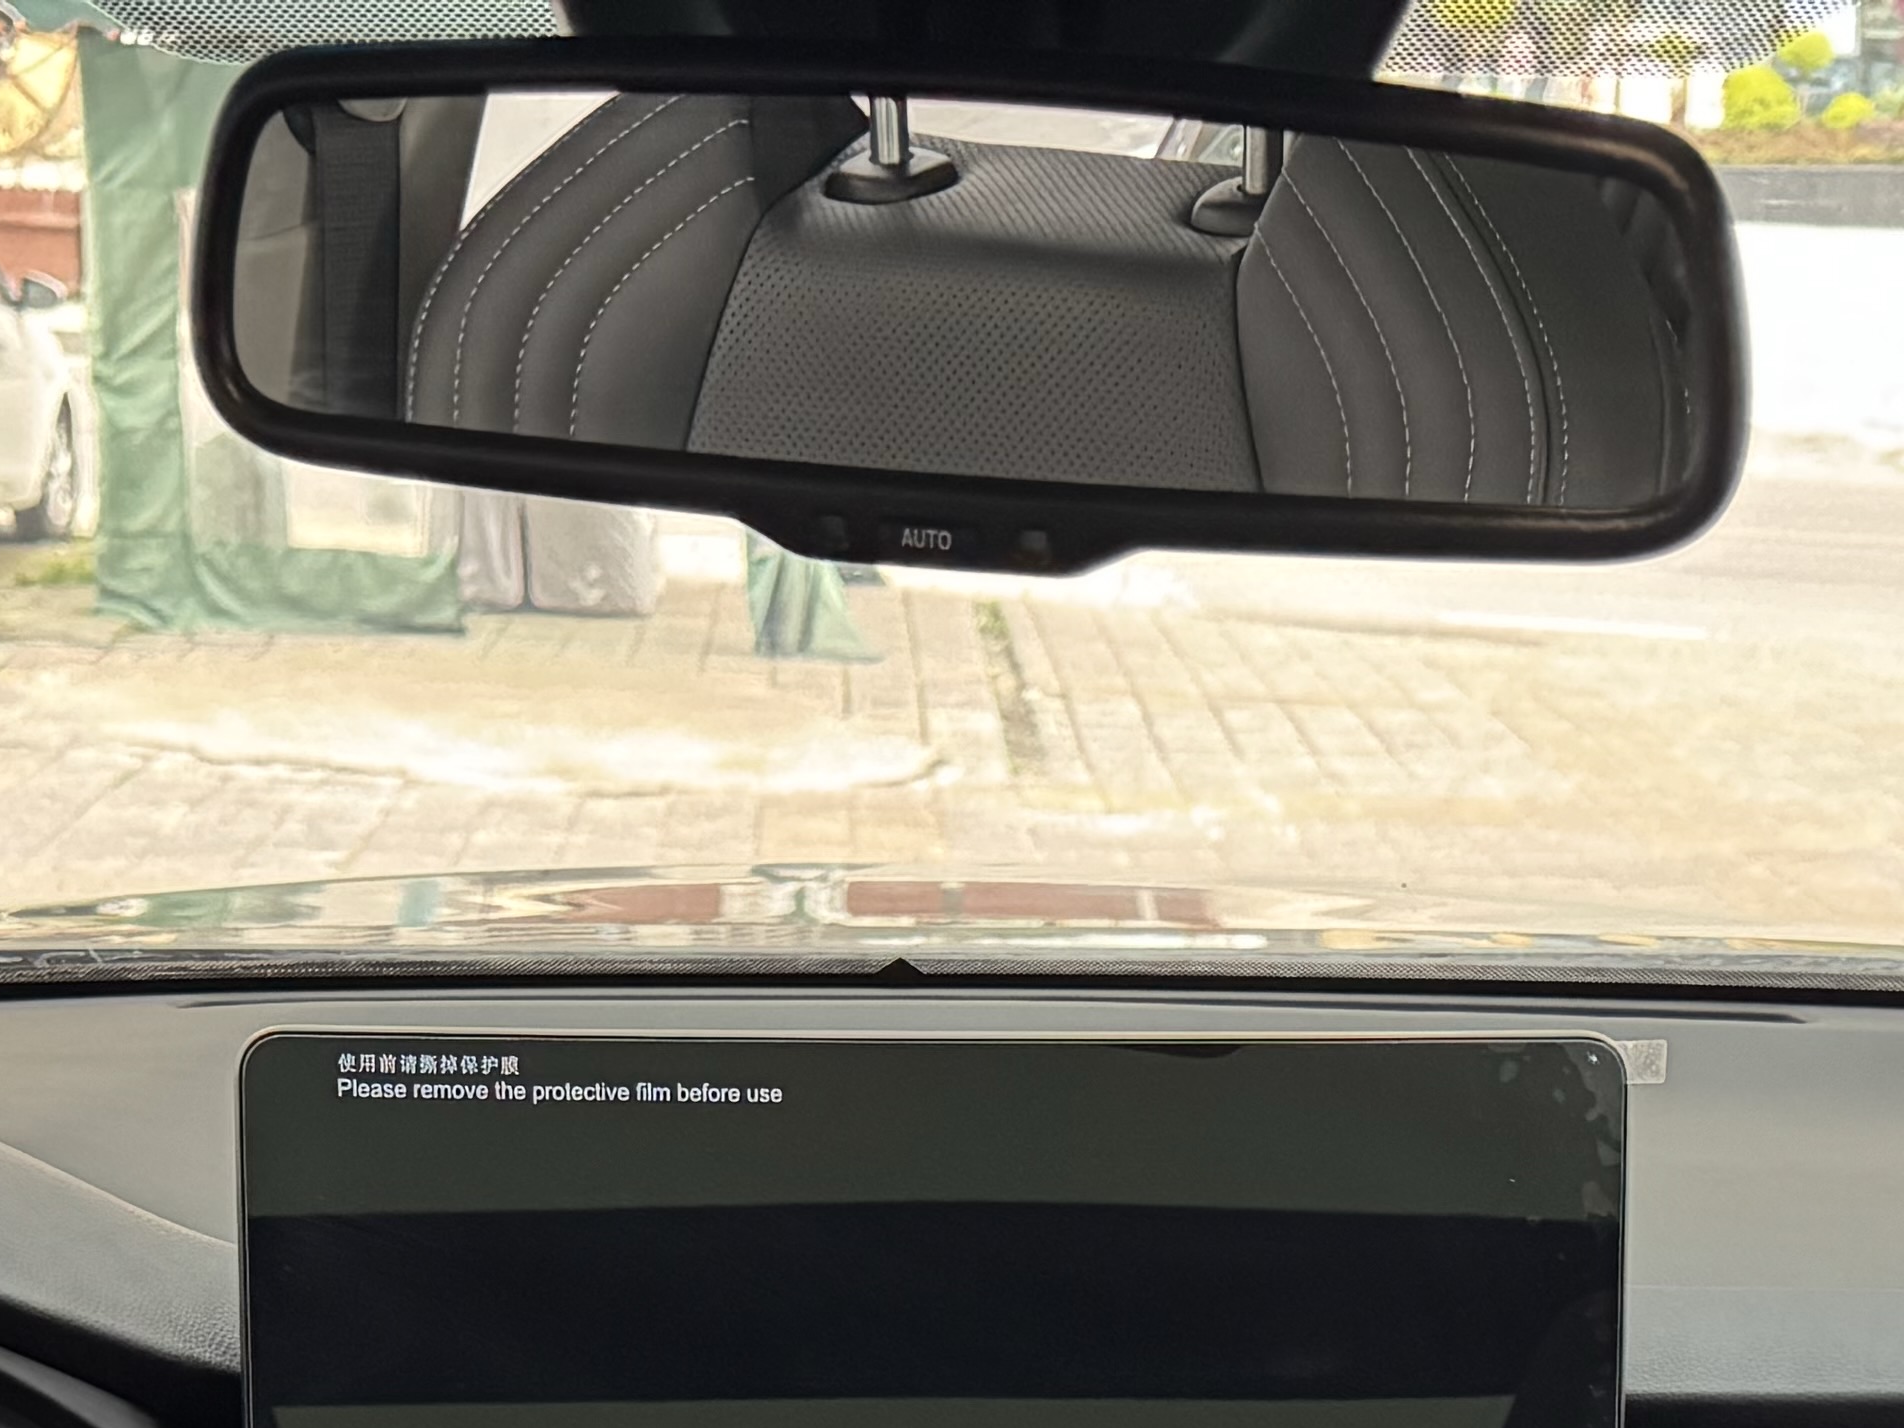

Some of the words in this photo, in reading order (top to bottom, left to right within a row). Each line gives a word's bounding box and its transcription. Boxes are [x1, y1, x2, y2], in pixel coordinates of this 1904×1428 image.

[901, 527, 952, 551] AUTO
[337, 1053, 520, 1076] 使用前请撕掉保护膜
[337, 1077, 407, 1099] Please
[413, 1083, 489, 1100] remove
[494, 1080, 527, 1100] the
[532, 1081, 630, 1105] protective
[635, 1081, 671, 1102] film
[677, 1082, 741, 1103] before
[746, 1087, 783, 1103] use
